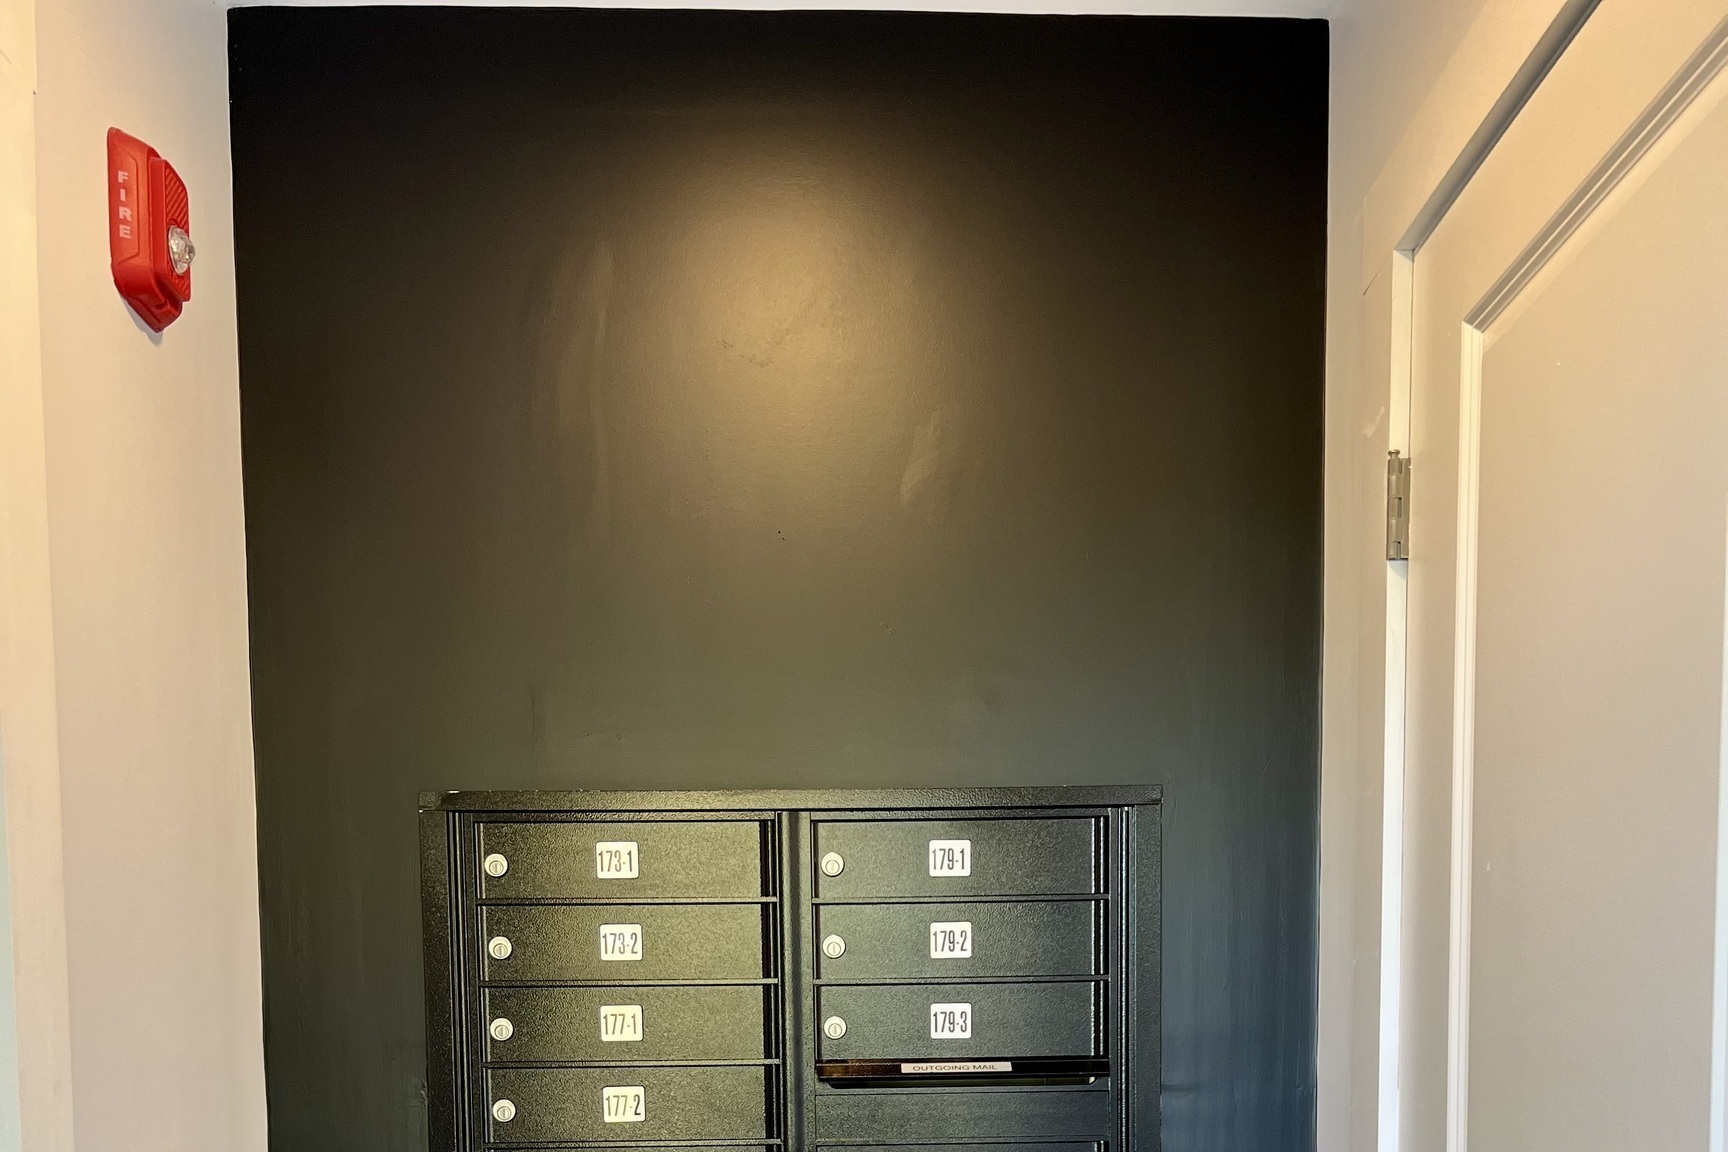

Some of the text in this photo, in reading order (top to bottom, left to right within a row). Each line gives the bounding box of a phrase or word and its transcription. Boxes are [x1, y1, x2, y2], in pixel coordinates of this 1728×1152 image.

[117, 170, 132, 240] FIRE
[598, 850, 634, 873] 173-1
[931, 848, 965, 870] 179-1
[602, 932, 638, 955] 173-2
[933, 930, 967, 952] 179-2
[602, 1013, 637, 1036] 177-1
[933, 1011, 967, 1033] 179-3
[605, 1094, 641, 1117] 177-2
